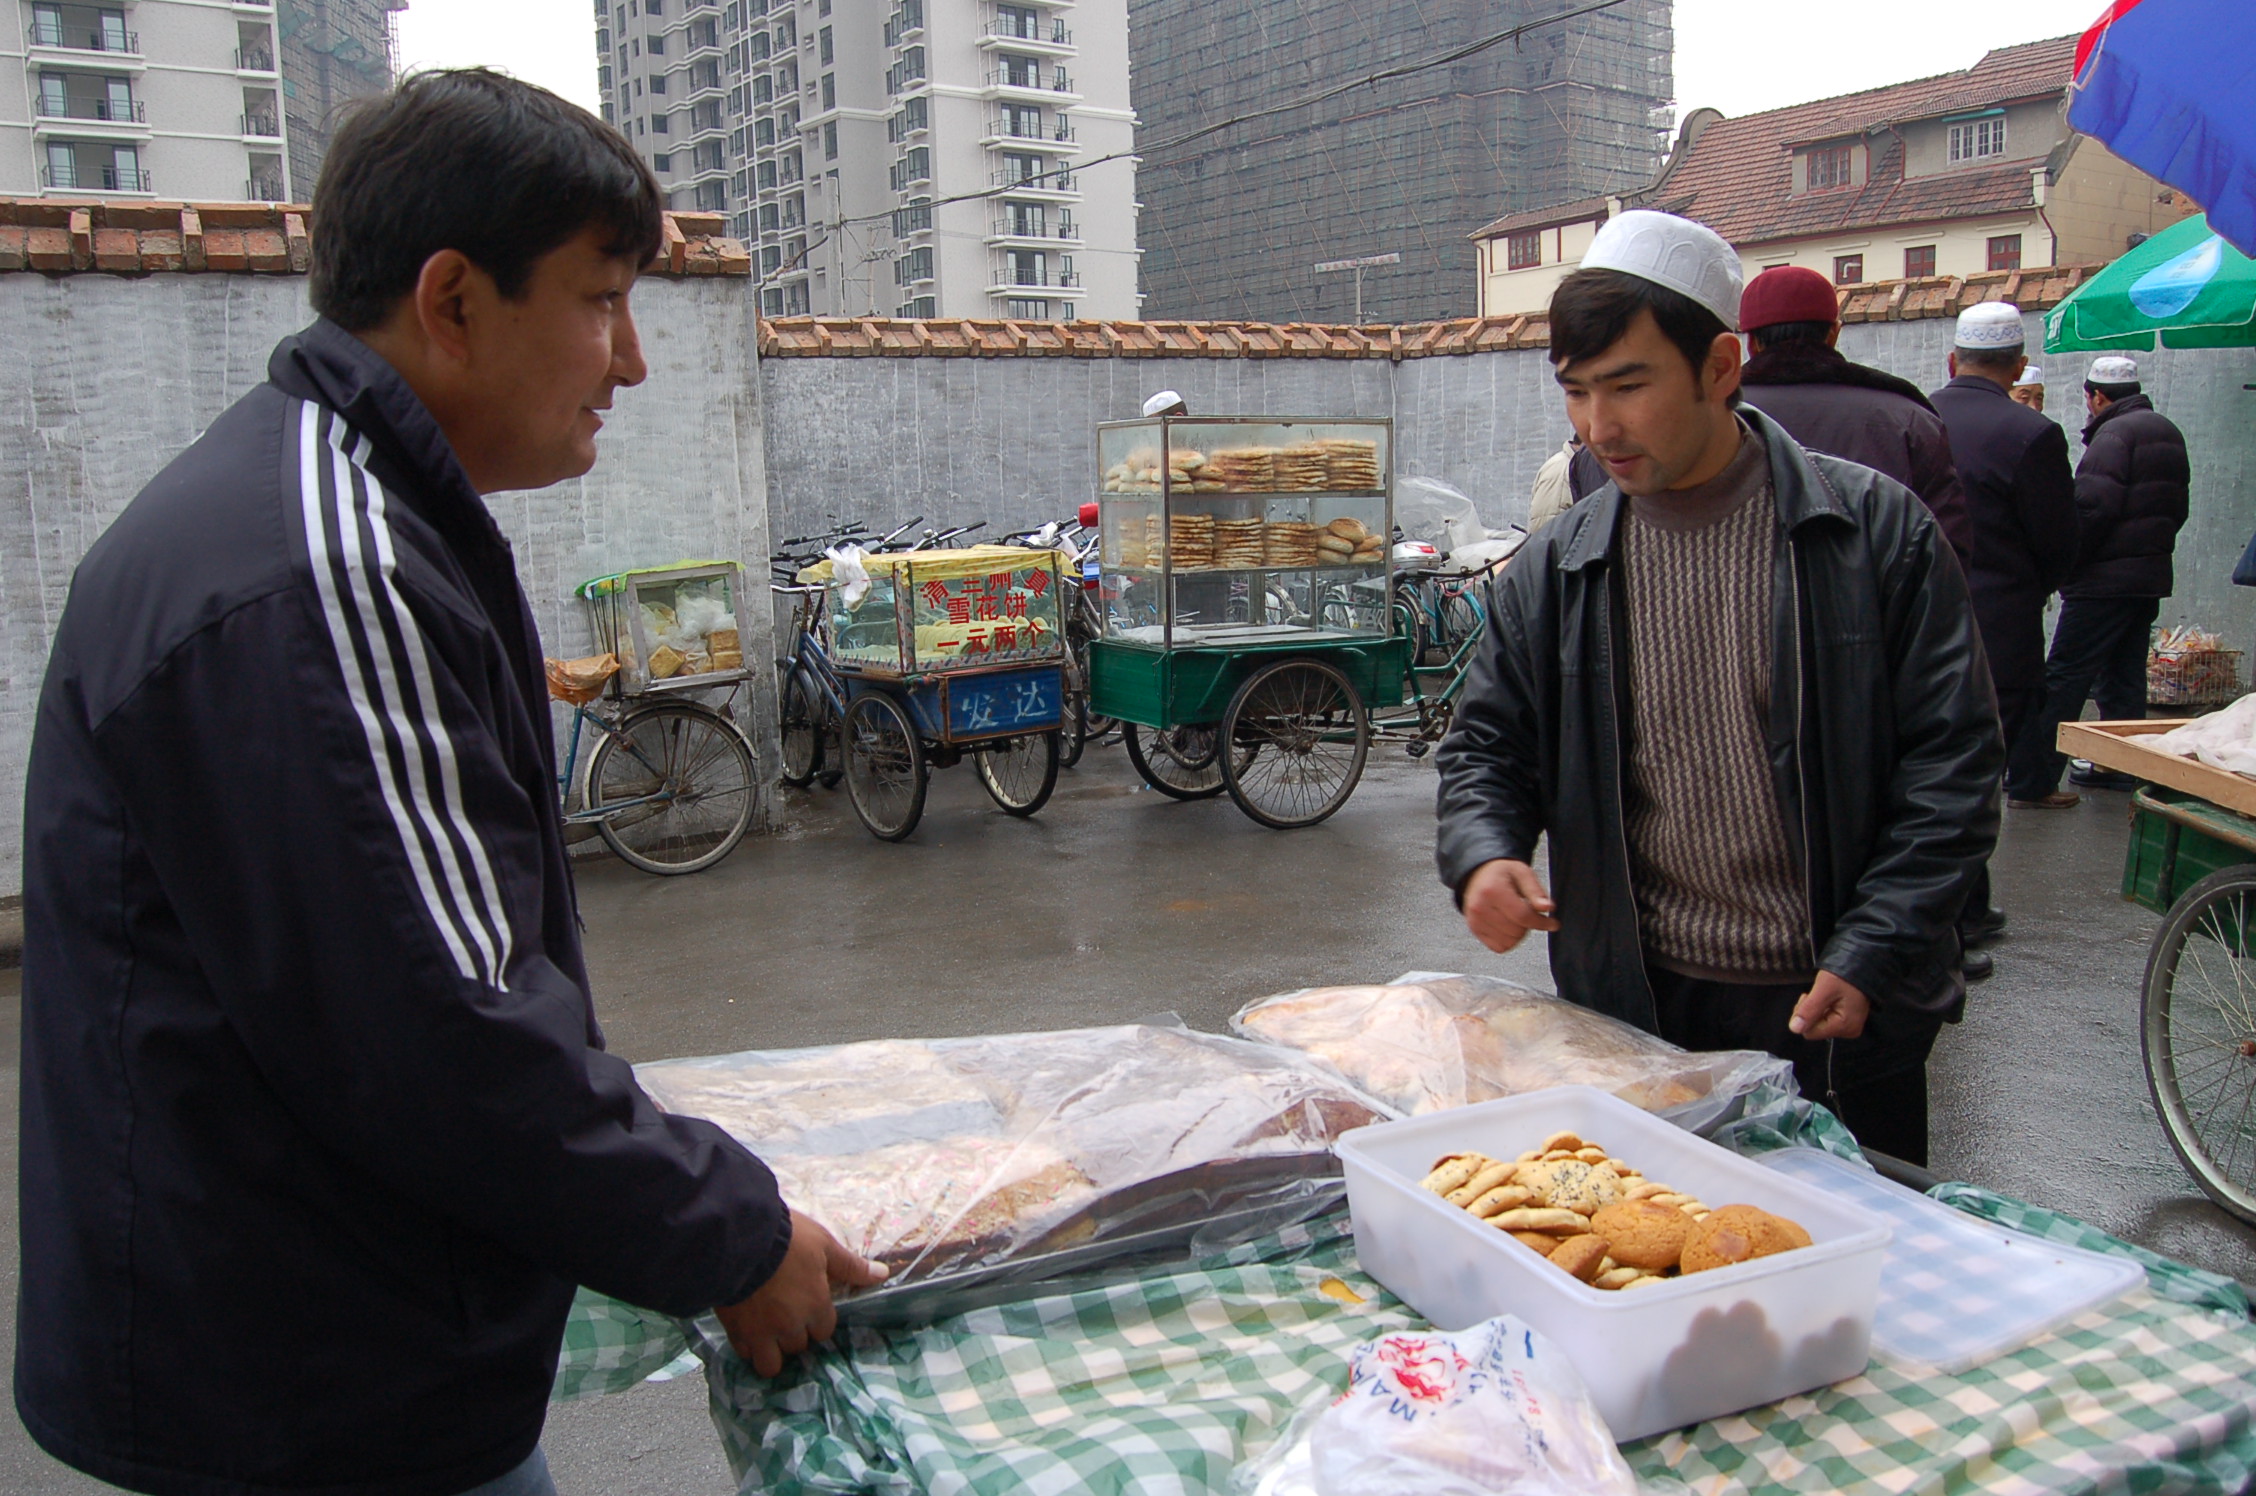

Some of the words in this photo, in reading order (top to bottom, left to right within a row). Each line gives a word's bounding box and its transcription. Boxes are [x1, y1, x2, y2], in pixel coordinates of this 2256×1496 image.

[946, 592, 1027, 625] 雪花饼
[937, 621, 1045, 654] 一元两个
